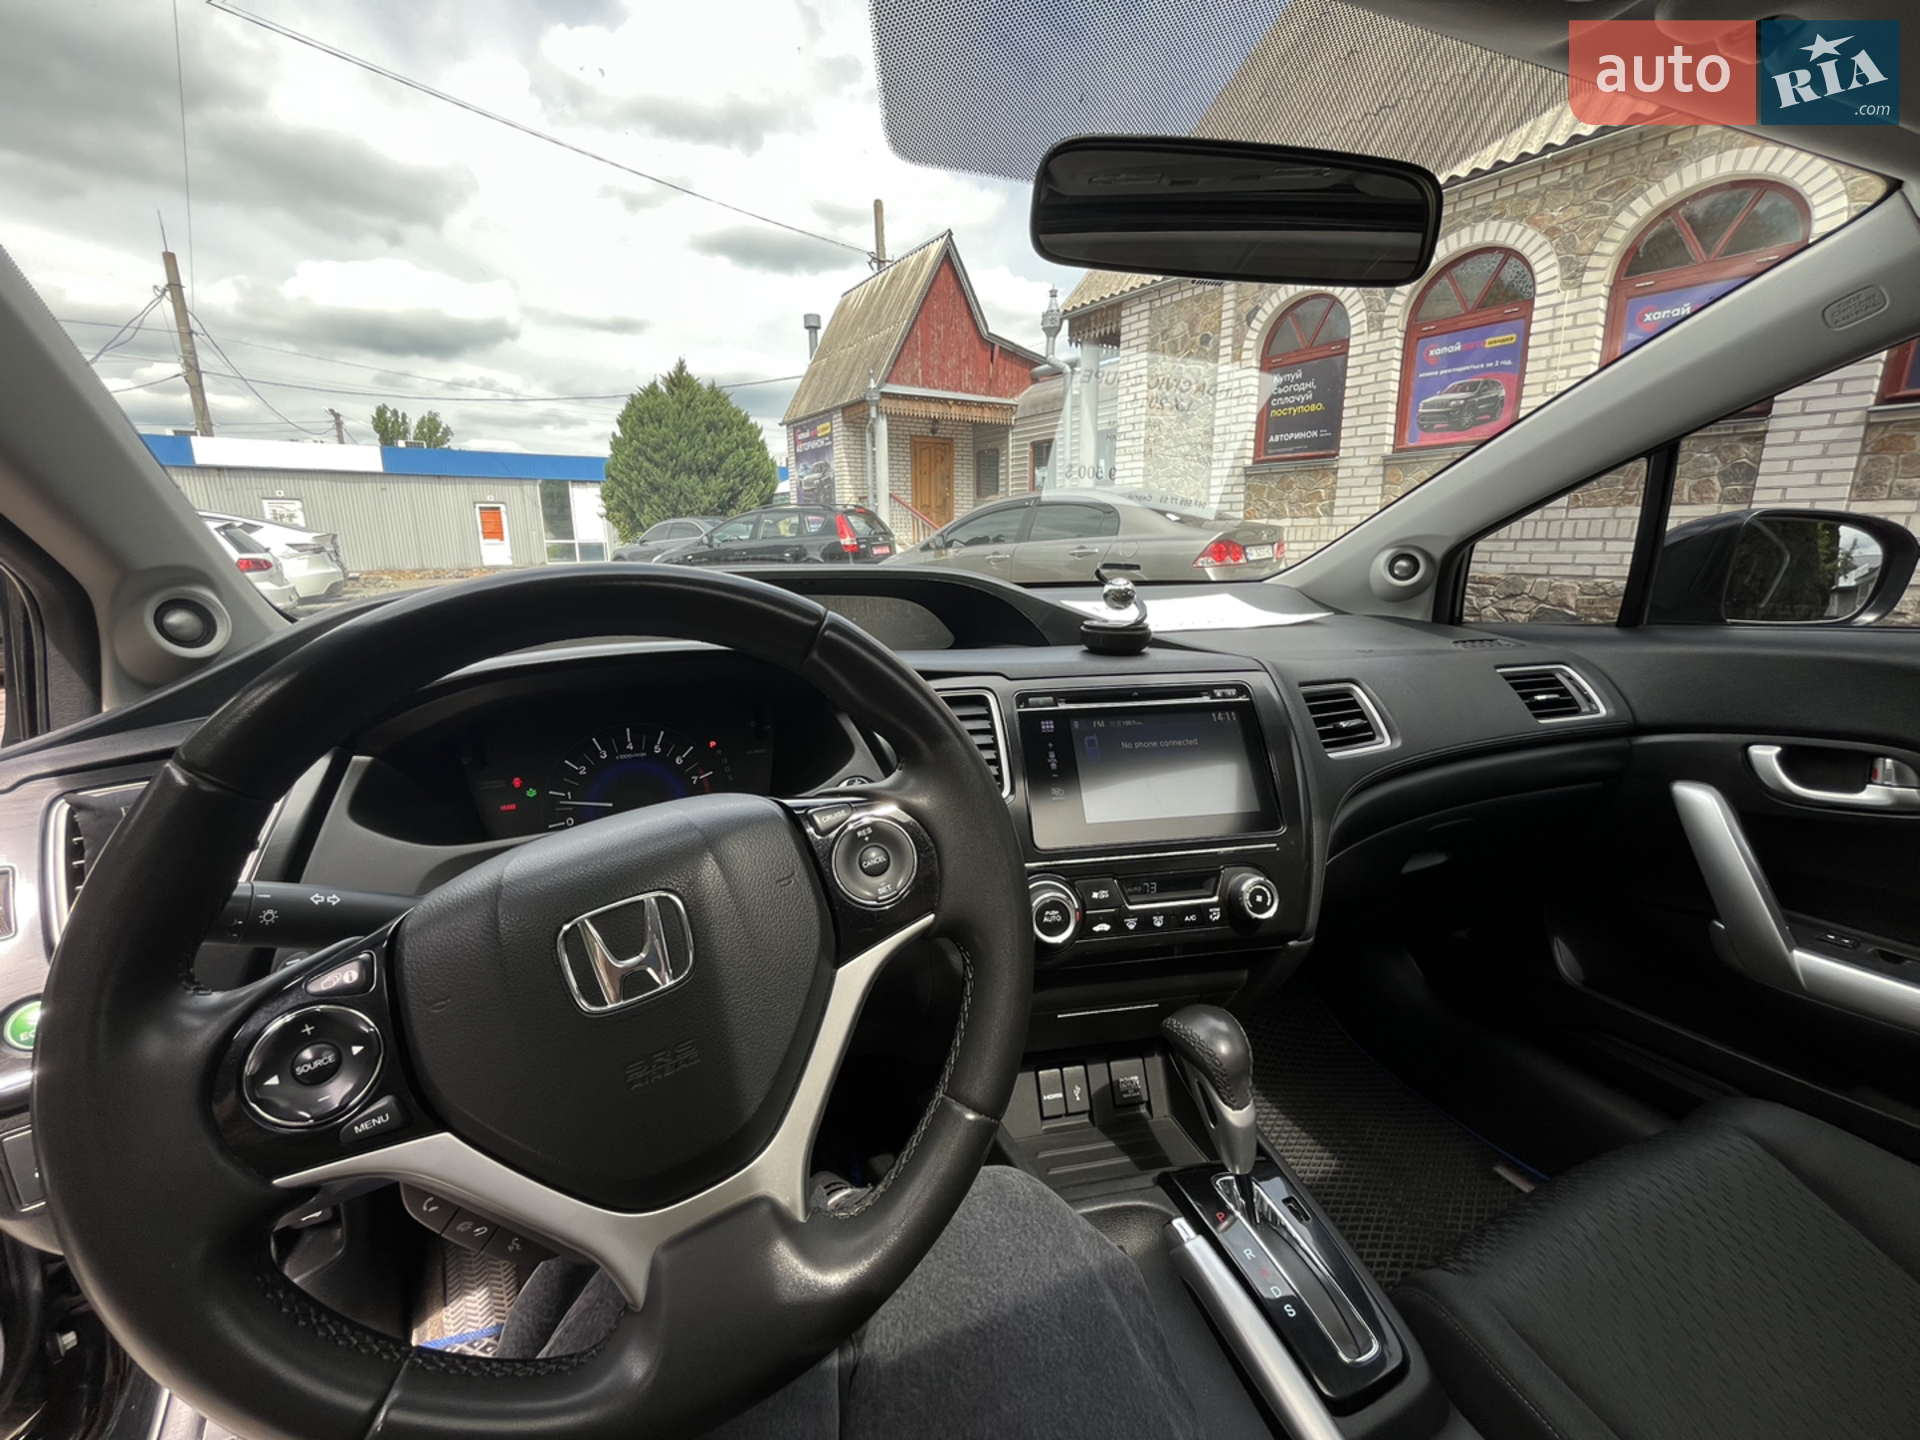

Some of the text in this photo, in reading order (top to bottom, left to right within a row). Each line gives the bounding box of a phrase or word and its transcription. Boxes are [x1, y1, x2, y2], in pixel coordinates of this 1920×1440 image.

[1642, 302, 1691, 323] хапай
[1428, 341, 1462, 357] хапай
[1272, 368, 1303, 384] Купуй
[1271, 378, 1317, 395] сьогодні,
[1270, 391, 1313, 406] сплачуй
[1270, 402, 1325, 417] поступово.
[1268, 430, 1319, 443] АВТОРИНОК
[1211, 711, 1236, 722] 14:11
[1092, 720, 1104, 728] FM
[626, 742, 633, 750] 4
[654, 744, 661, 753] 5
[1121, 738, 1199, 750] No phone connected
[600, 750, 607, 759] 3
[675, 756, 683, 765] 6
[579, 766, 587, 775] 2
[691, 776, 698, 784] 7
[566, 817, 574, 826] 0
[821, 809, 848, 823] CRUISE
[856, 827, 873, 838] RES
[861, 855, 887, 869] CANCEL
[877, 884, 893, 896] SET
[1142, 882, 1157, 894] 73
[1042, 915, 1062, 923] AUTO
[1184, 914, 1197, 922] A/C
[295, 1052, 336, 1075] SOURCE
[354, 1113, 390, 1134] MENU
[1216, 1212, 1225, 1222] P
[1243, 1248, 1256, 1260] R
[1270, 1285, 1283, 1299] D
[1283, 1303, 1297, 1318] S
